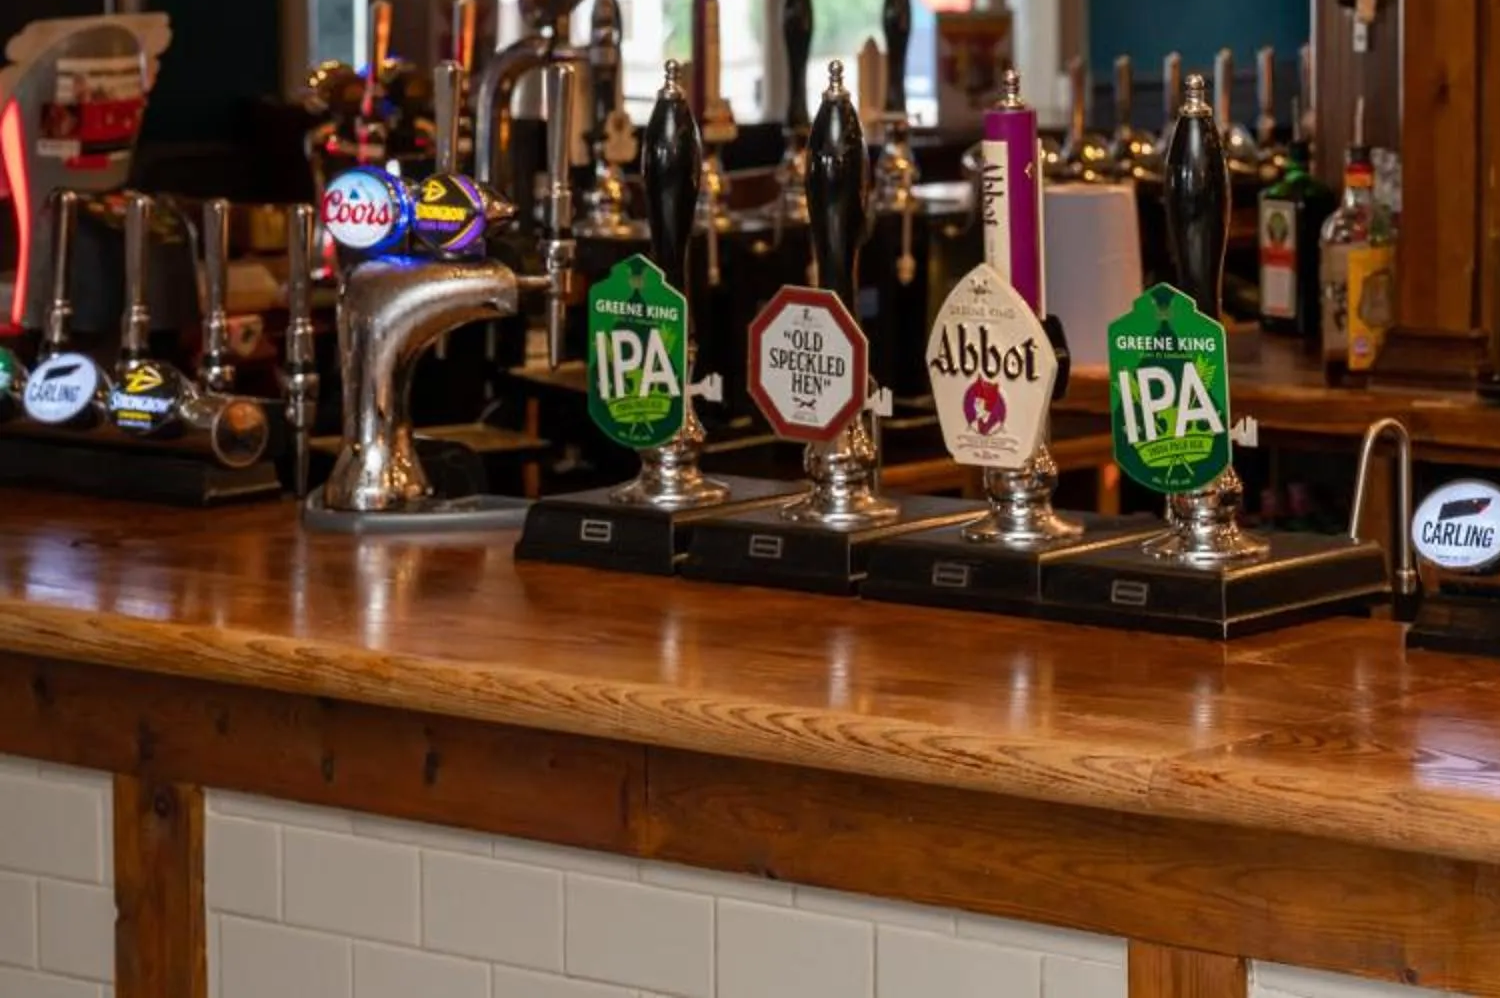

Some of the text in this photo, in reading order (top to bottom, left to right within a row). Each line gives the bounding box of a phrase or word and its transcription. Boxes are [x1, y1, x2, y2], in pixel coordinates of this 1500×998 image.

[320, 188, 394, 226] Coors
[595, 299, 679, 321] GREENE KING
[929, 323, 1040, 382] Abbot
[1116, 335, 1217, 352] GREENE KING
[595, 328, 681, 400] IPA
[769, 347, 846, 378] SPECKLED
[28, 382, 82, 403] CARLING
[1118, 361, 1225, 444] IPA
[1422, 520, 1495, 549] CARLING
